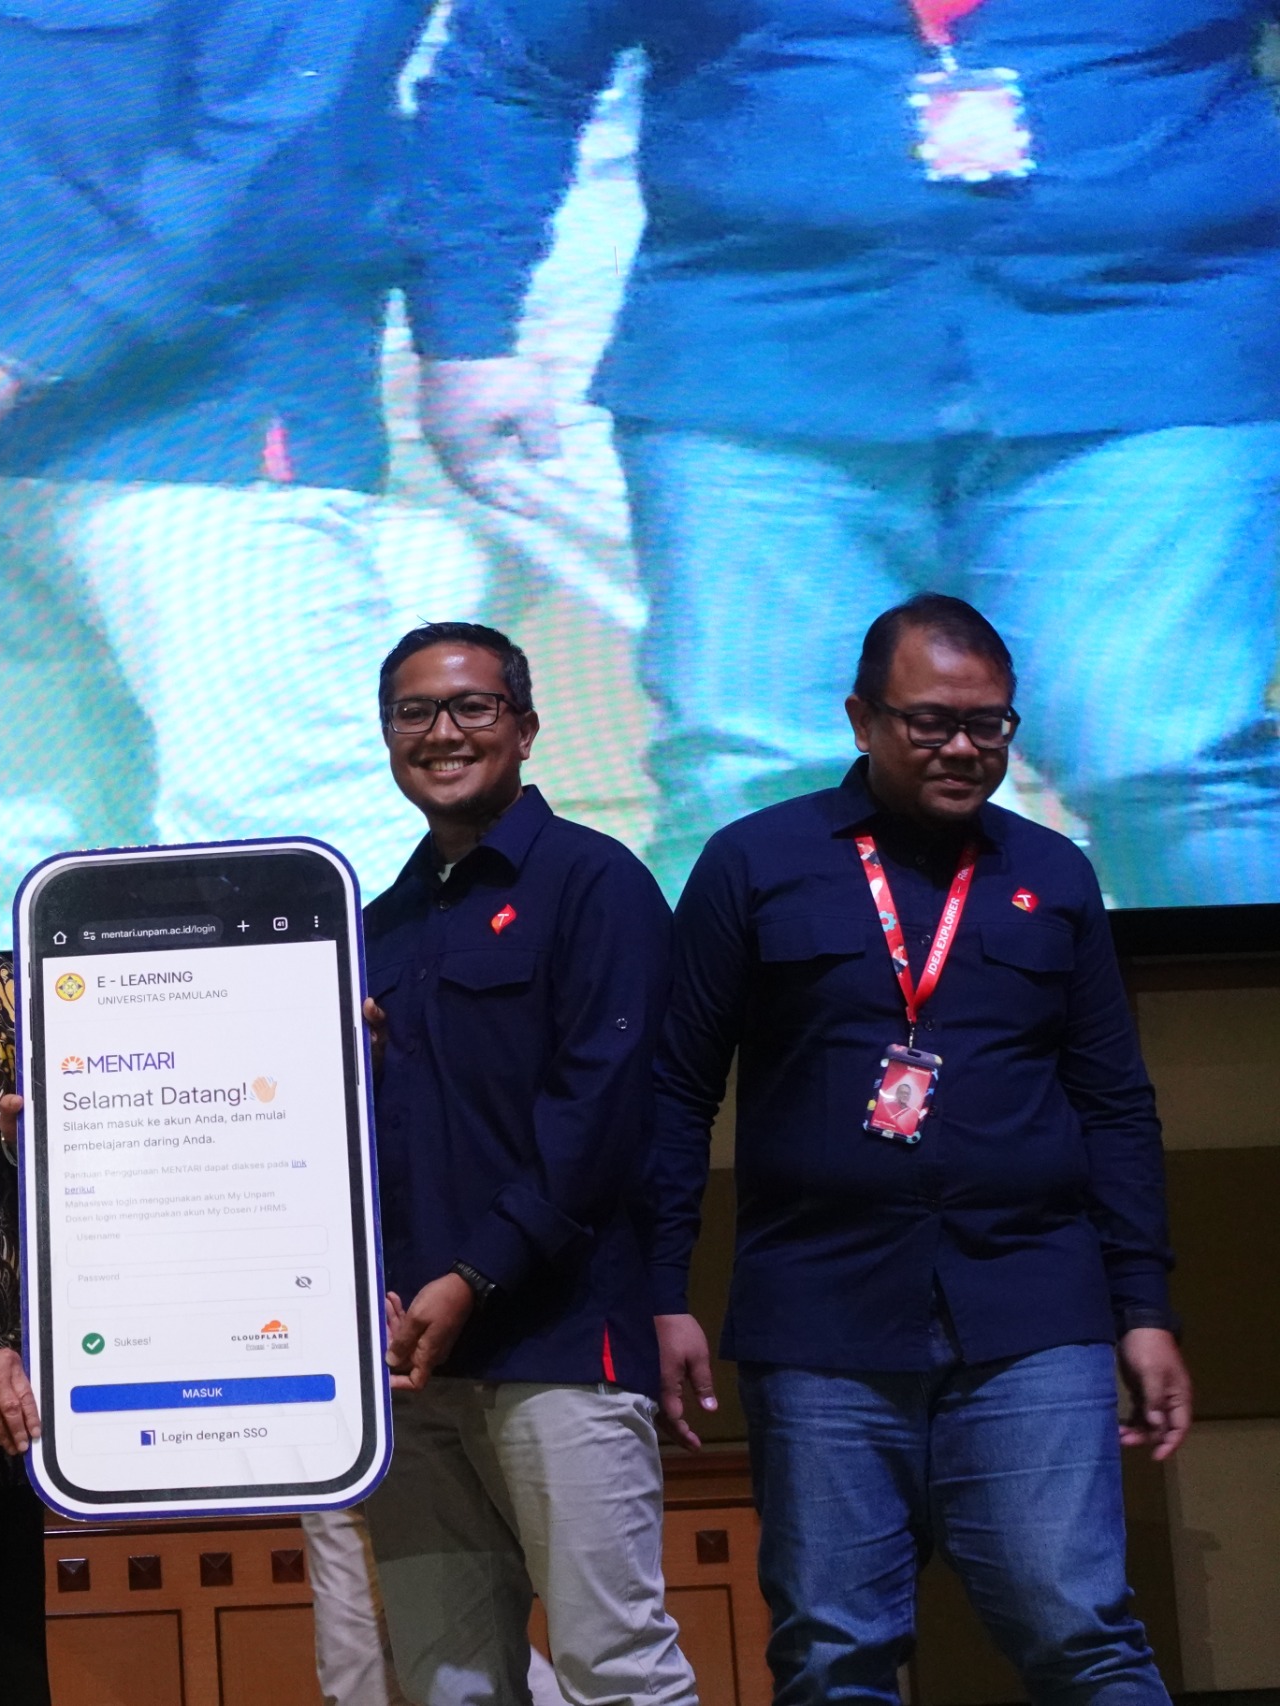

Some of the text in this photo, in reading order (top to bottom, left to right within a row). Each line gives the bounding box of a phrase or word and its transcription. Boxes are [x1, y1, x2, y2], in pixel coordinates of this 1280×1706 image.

[101, 923, 216, 940] mentari.unpam.ac.id/login
[927, 950, 943, 975] IDEA
[936, 897, 960, 949] EXPLORER
[97, 976, 106, 988] E
[120, 971, 194, 987] LEARNING
[97, 989, 228, 1006] UNIVERSITAS PAMULANG
[87, 1051, 175, 1074] MENTARI
[63, 1082, 247, 1111] Selamat Datang!
[63, 1110, 286, 1132] Silakan masuk ke akun Anda, dan mulai
[63, 1134, 216, 1153] pembelajaran daring Anda.
[161, 1165, 202, 1174] MENTARI
[204, 1163, 229, 1173] dapat
[291, 1159, 307, 1168] link
[64, 1186, 95, 1195] berikut
[228, 1191, 241, 1201] My
[183, 1208, 205, 1216] akun
[207, 1206, 221, 1217] My
[223, 1205, 252, 1214] Dosen
[260, 1203, 287, 1212] HRMS
[77, 1231, 121, 1241] Username
[77, 1272, 120, 1283] Password
[114, 1336, 152, 1347] Sukses!
[231, 1333, 289, 1341] CLOUDFLARE
[182, 1387, 223, 1399] MASUK
[161, 1427, 268, 1444] Login dengan SSO
